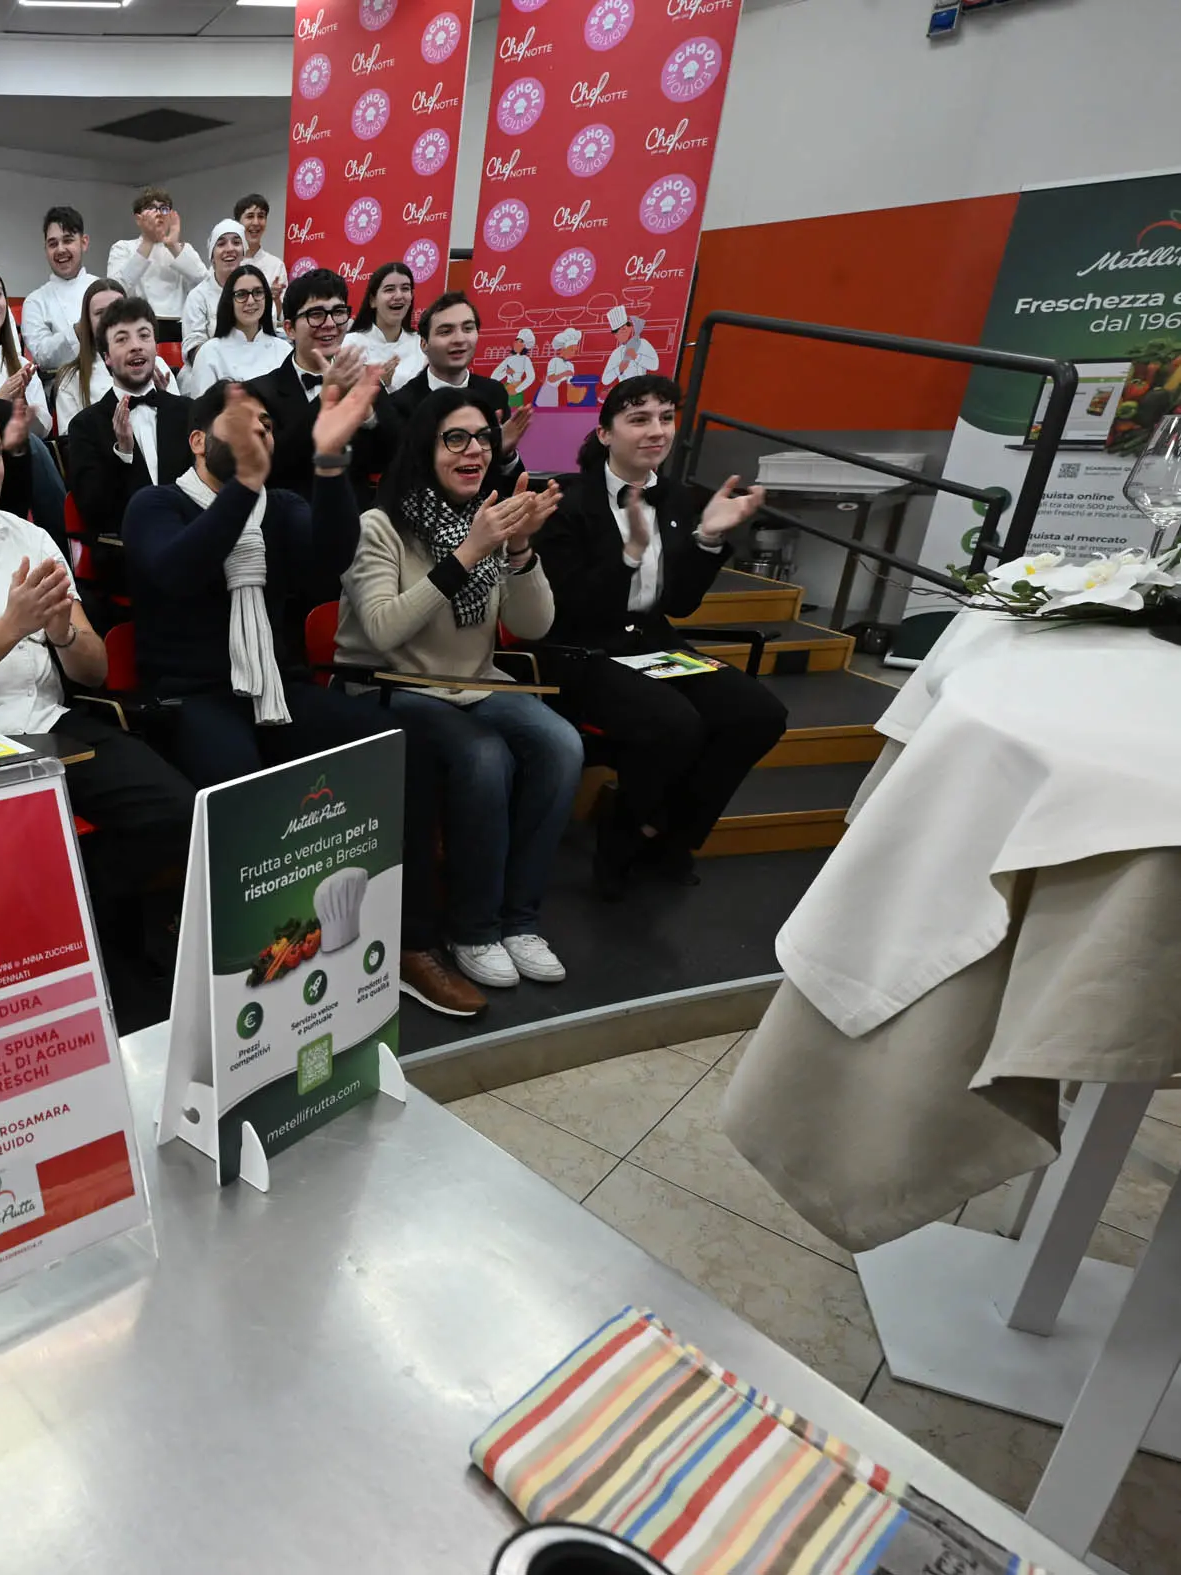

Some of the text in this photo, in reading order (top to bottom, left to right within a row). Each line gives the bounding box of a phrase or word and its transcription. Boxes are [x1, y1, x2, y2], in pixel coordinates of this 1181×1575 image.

[317, 23, 338, 36] NOTTE
[524, 44, 553, 58] NOTTE
[668, 43, 715, 72] SCHOOL
[372, 58, 395, 71] NOTTE
[434, 97, 459, 110] NOTTE
[502, 83, 540, 108] SCHOOL
[597, 90, 628, 104] NOTTE
[310, 129, 331, 140] NOTTE
[573, 129, 610, 152] SCHOOL
[675, 137, 708, 151] NOTTE
[364, 167, 386, 178] NOTTE
[510, 166, 537, 178] NOTTE
[646, 180, 691, 206] SCHOOL
[424, 211, 448, 222] NOTTE
[489, 204, 524, 226] SCHOOL
[579, 218, 608, 229] NOTTE
[305, 232, 325, 241] NOTTE
[556, 253, 592, 274] SCHOOL
[653, 268, 685, 279] NOTTE
[496, 283, 522, 292] NOTTE
[1014, 292, 1166, 315] Freschezza
[1089, 313, 1132, 332] dal
[1077, 492, 1115, 501] online
[1086, 502, 1105, 510] 500
[1063, 533, 1074, 541] al
[1077, 535, 1127, 544] mercato
[240, 818, 379, 883] Frutta e verdura per la
[244, 836, 378, 901] ristorazione a Brescia
[22, 952, 44, 966] ANNA
[44, 940, 84, 959] ZUCCHELLI
[291, 1000, 339, 1031] Servizio veloce
[303, 1012, 333, 1035] puntuale
[4, 1028, 60, 1056] SPUMA
[15, 1054, 31, 1070] DI
[36, 1031, 96, 1063] AGRUMI
[238, 1040, 261, 1059] Prezzi
[229, 1044, 271, 1072] competitivi
[0, 1103, 71, 1138] ROSAMARA
[266, 1079, 361, 1145] metellifrutta.com
